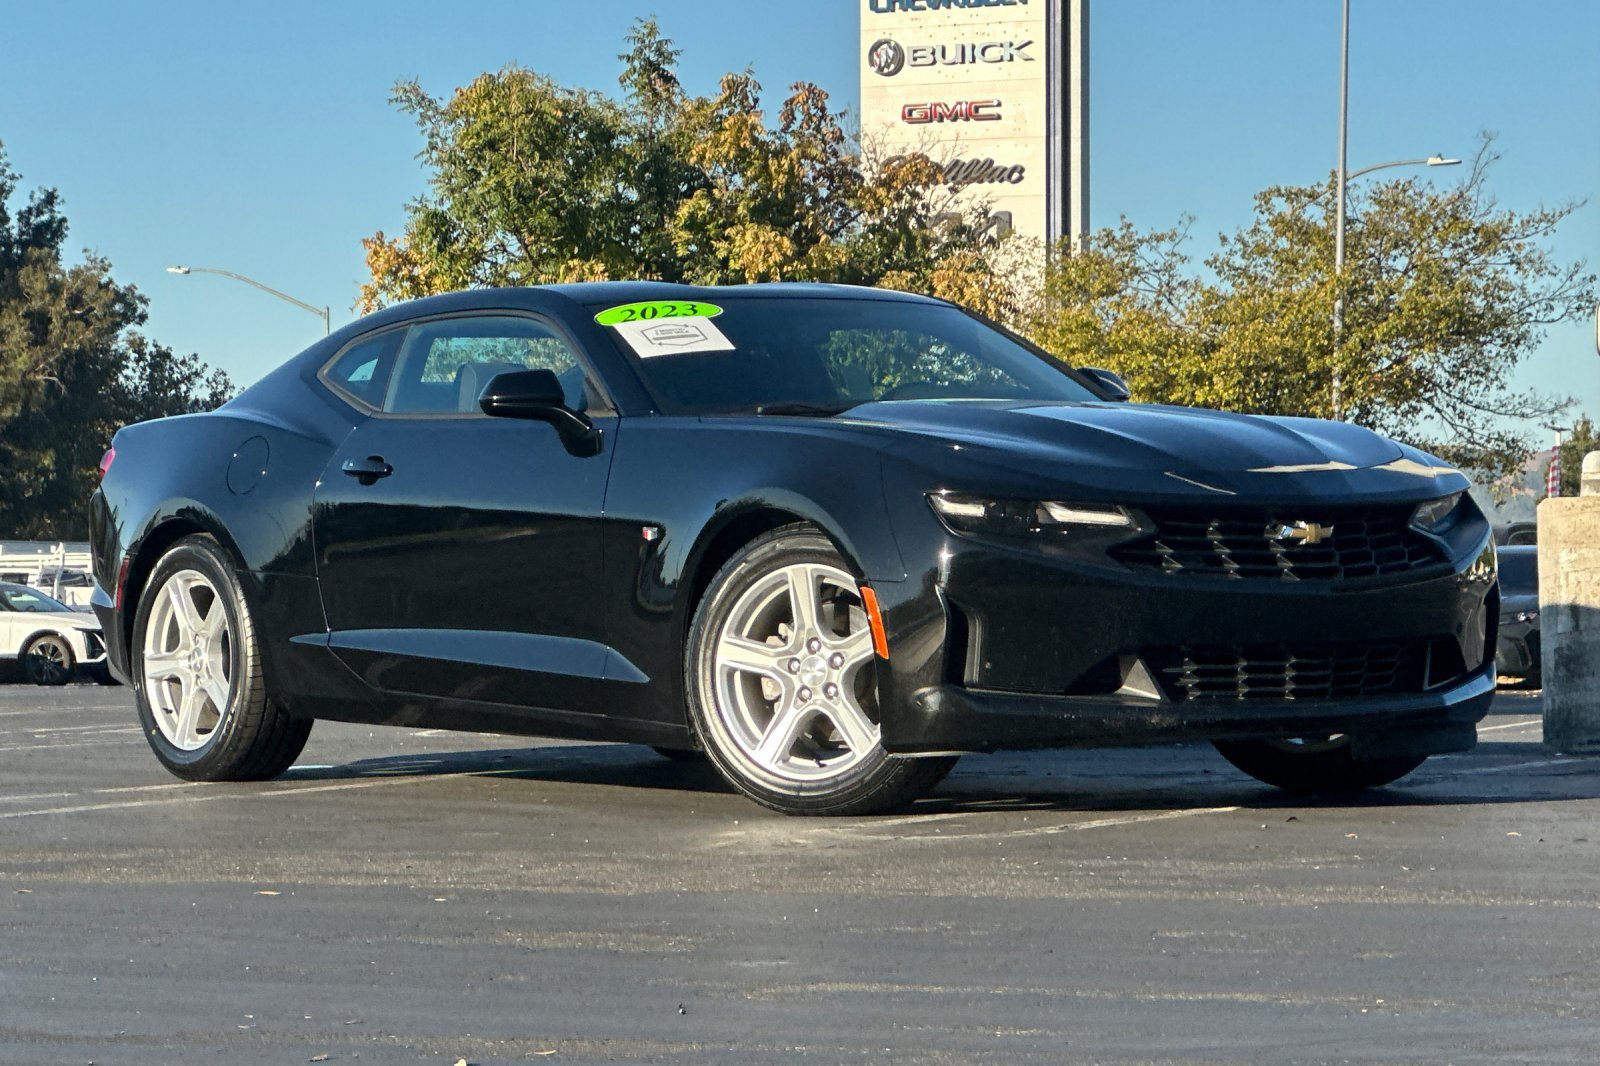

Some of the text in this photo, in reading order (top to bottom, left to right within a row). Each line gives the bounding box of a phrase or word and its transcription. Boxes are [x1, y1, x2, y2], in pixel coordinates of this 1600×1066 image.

[907, 40, 1034, 67] BUICK
[901, 99, 1002, 124] GMC
[620, 304, 698, 323] 2023
